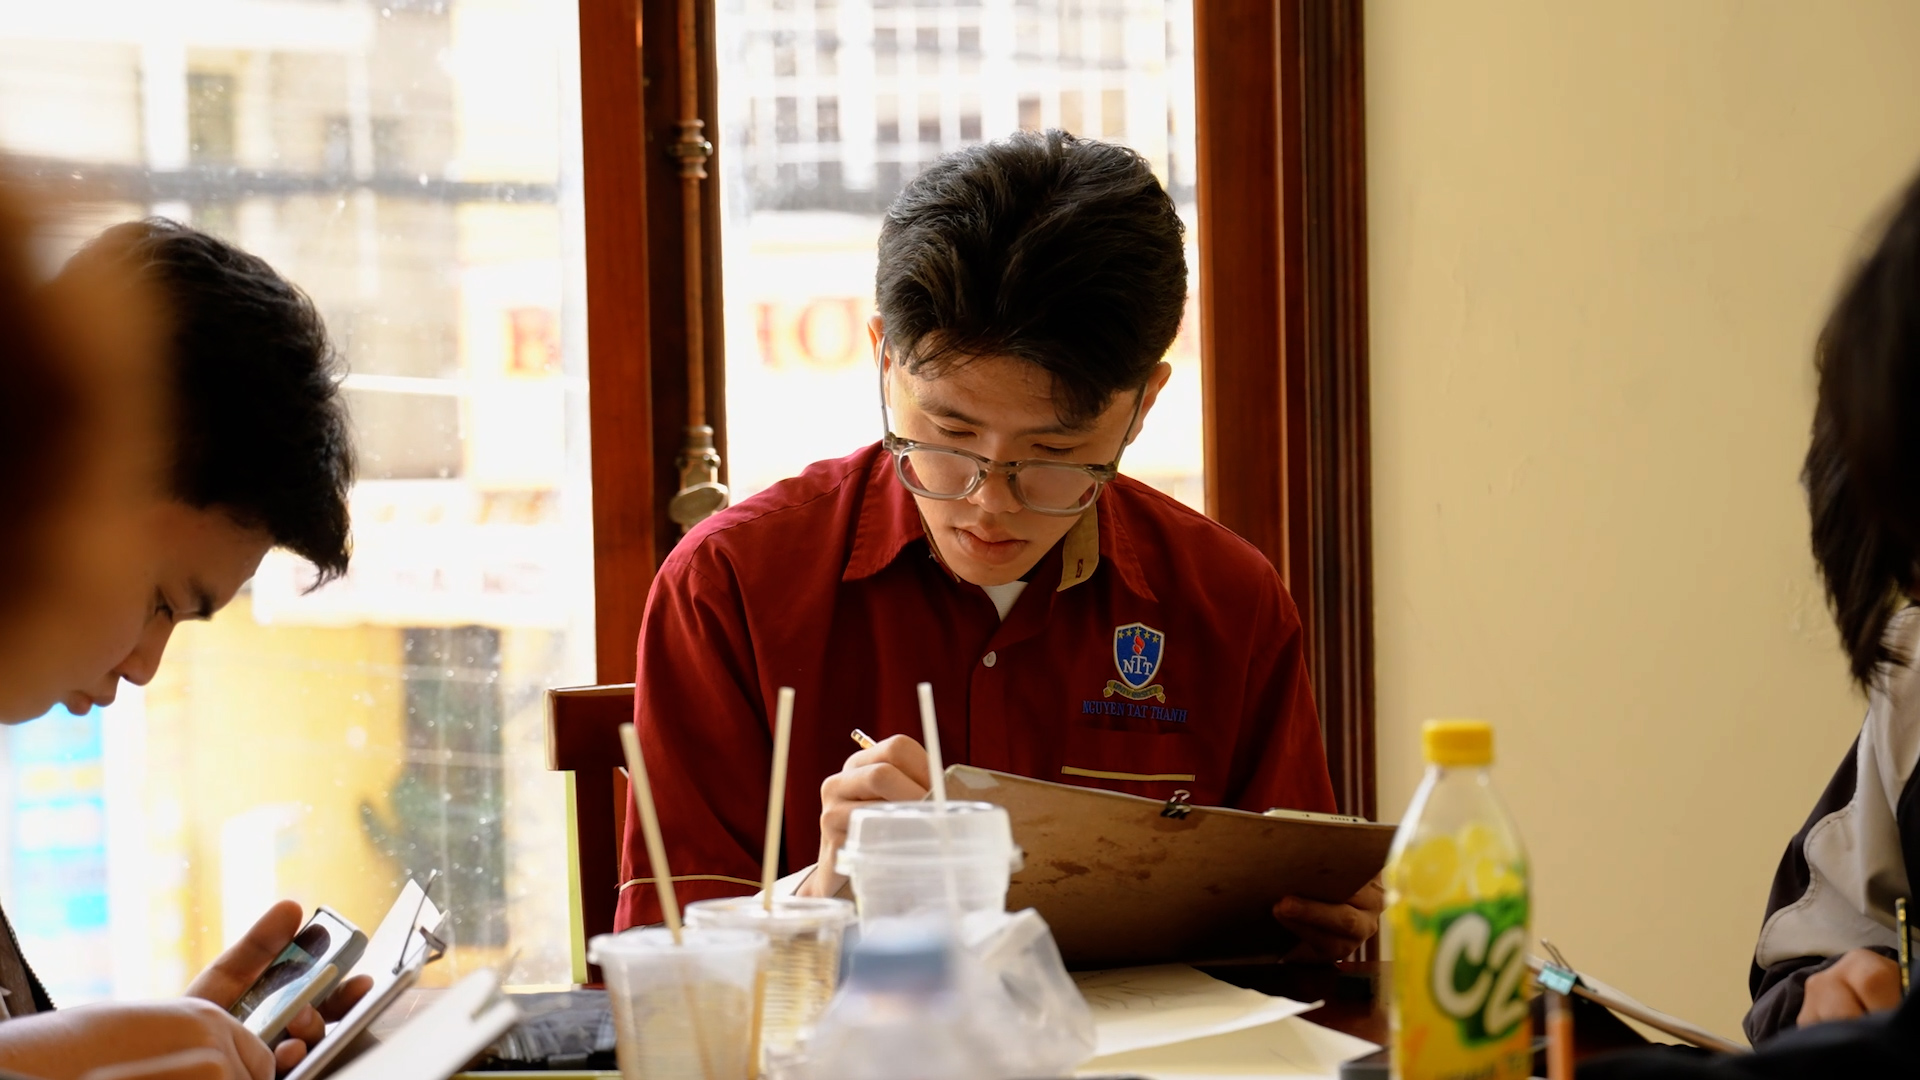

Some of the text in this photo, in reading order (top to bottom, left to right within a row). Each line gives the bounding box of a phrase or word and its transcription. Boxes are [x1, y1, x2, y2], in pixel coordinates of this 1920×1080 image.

[1122, 655, 1153, 676] NTT
[1082, 700, 1188, 723] NGUYEN TAT THANH
[1434, 912, 1529, 1036] C2
